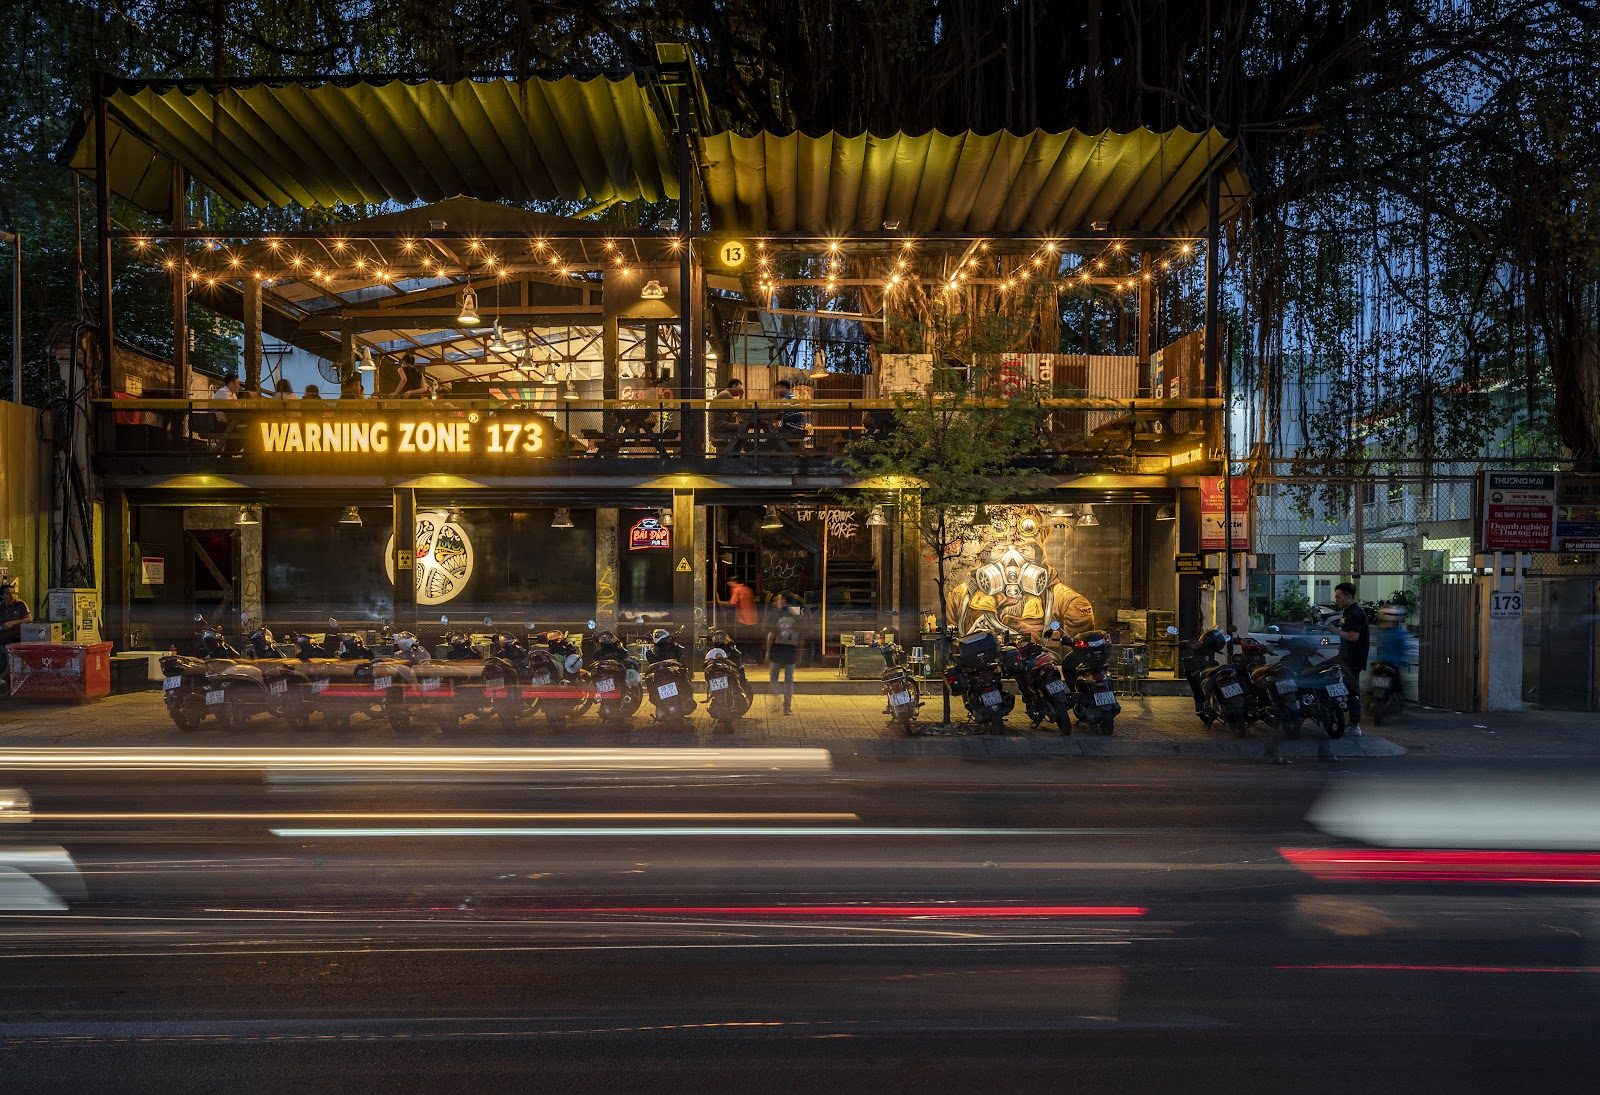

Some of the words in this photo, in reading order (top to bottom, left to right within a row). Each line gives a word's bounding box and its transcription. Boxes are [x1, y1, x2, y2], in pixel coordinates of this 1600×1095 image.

[725, 247, 741, 261] 13
[260, 421, 388, 453] WARNING
[398, 421, 470, 453] ZONE
[487, 421, 544, 453] 173
[797, 510, 815, 522] EAT
[827, 509, 856, 523] DRINK
[1494, 596, 1521, 610] 173
